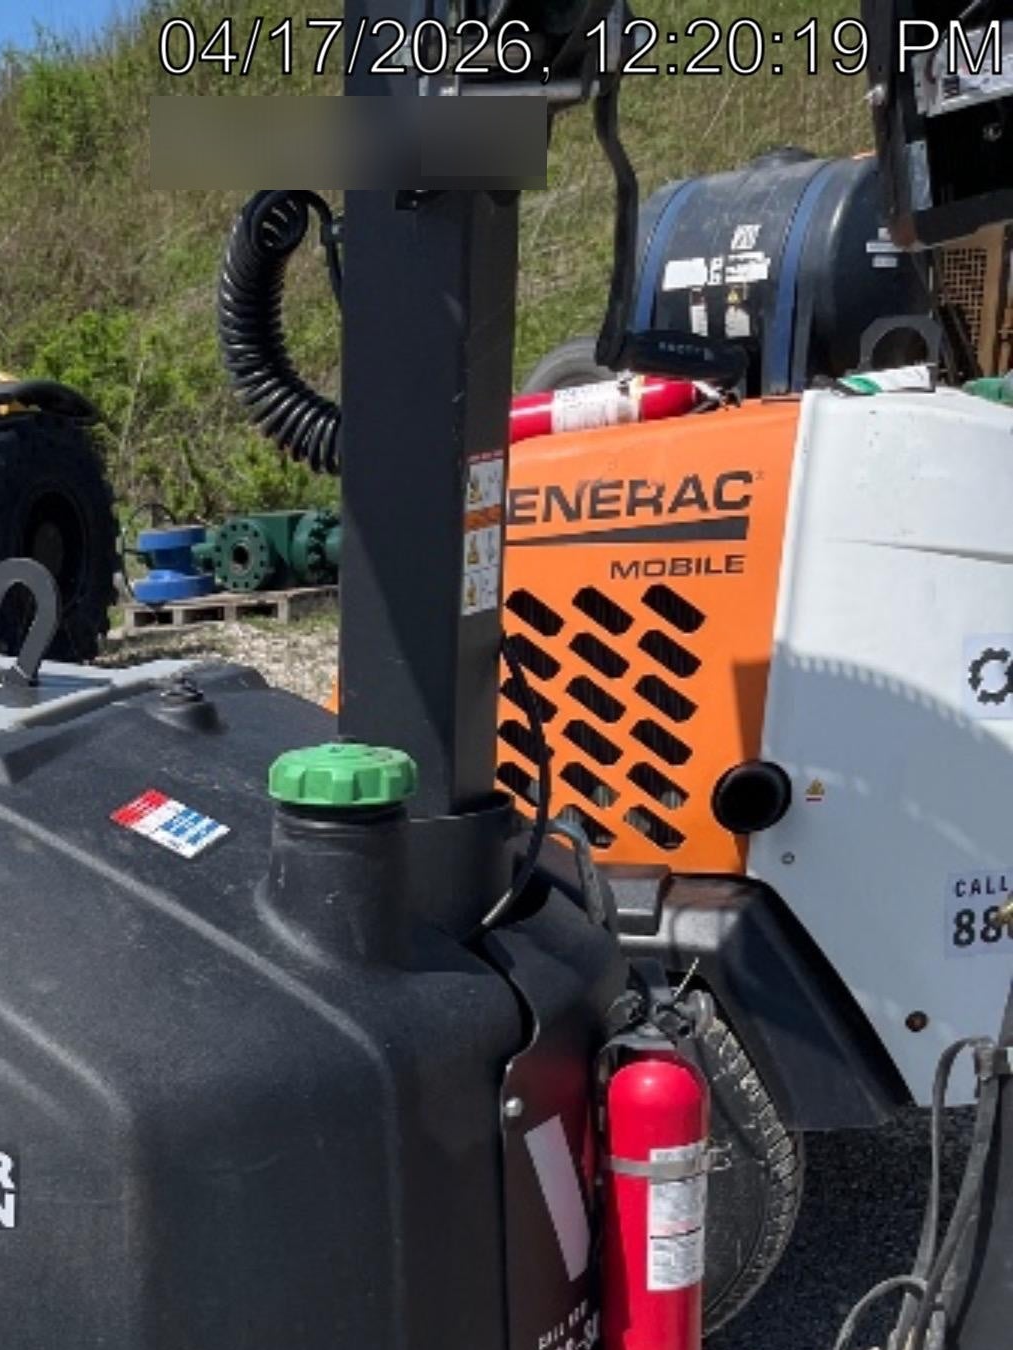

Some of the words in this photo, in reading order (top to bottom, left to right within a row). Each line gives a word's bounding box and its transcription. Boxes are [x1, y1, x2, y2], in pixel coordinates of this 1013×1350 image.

[505, 470, 753, 525] ENERAC
[610, 554, 745, 579] MOBILE
[955, 874, 1009, 898] CALL
[952, 905, 1013, 948] 88
